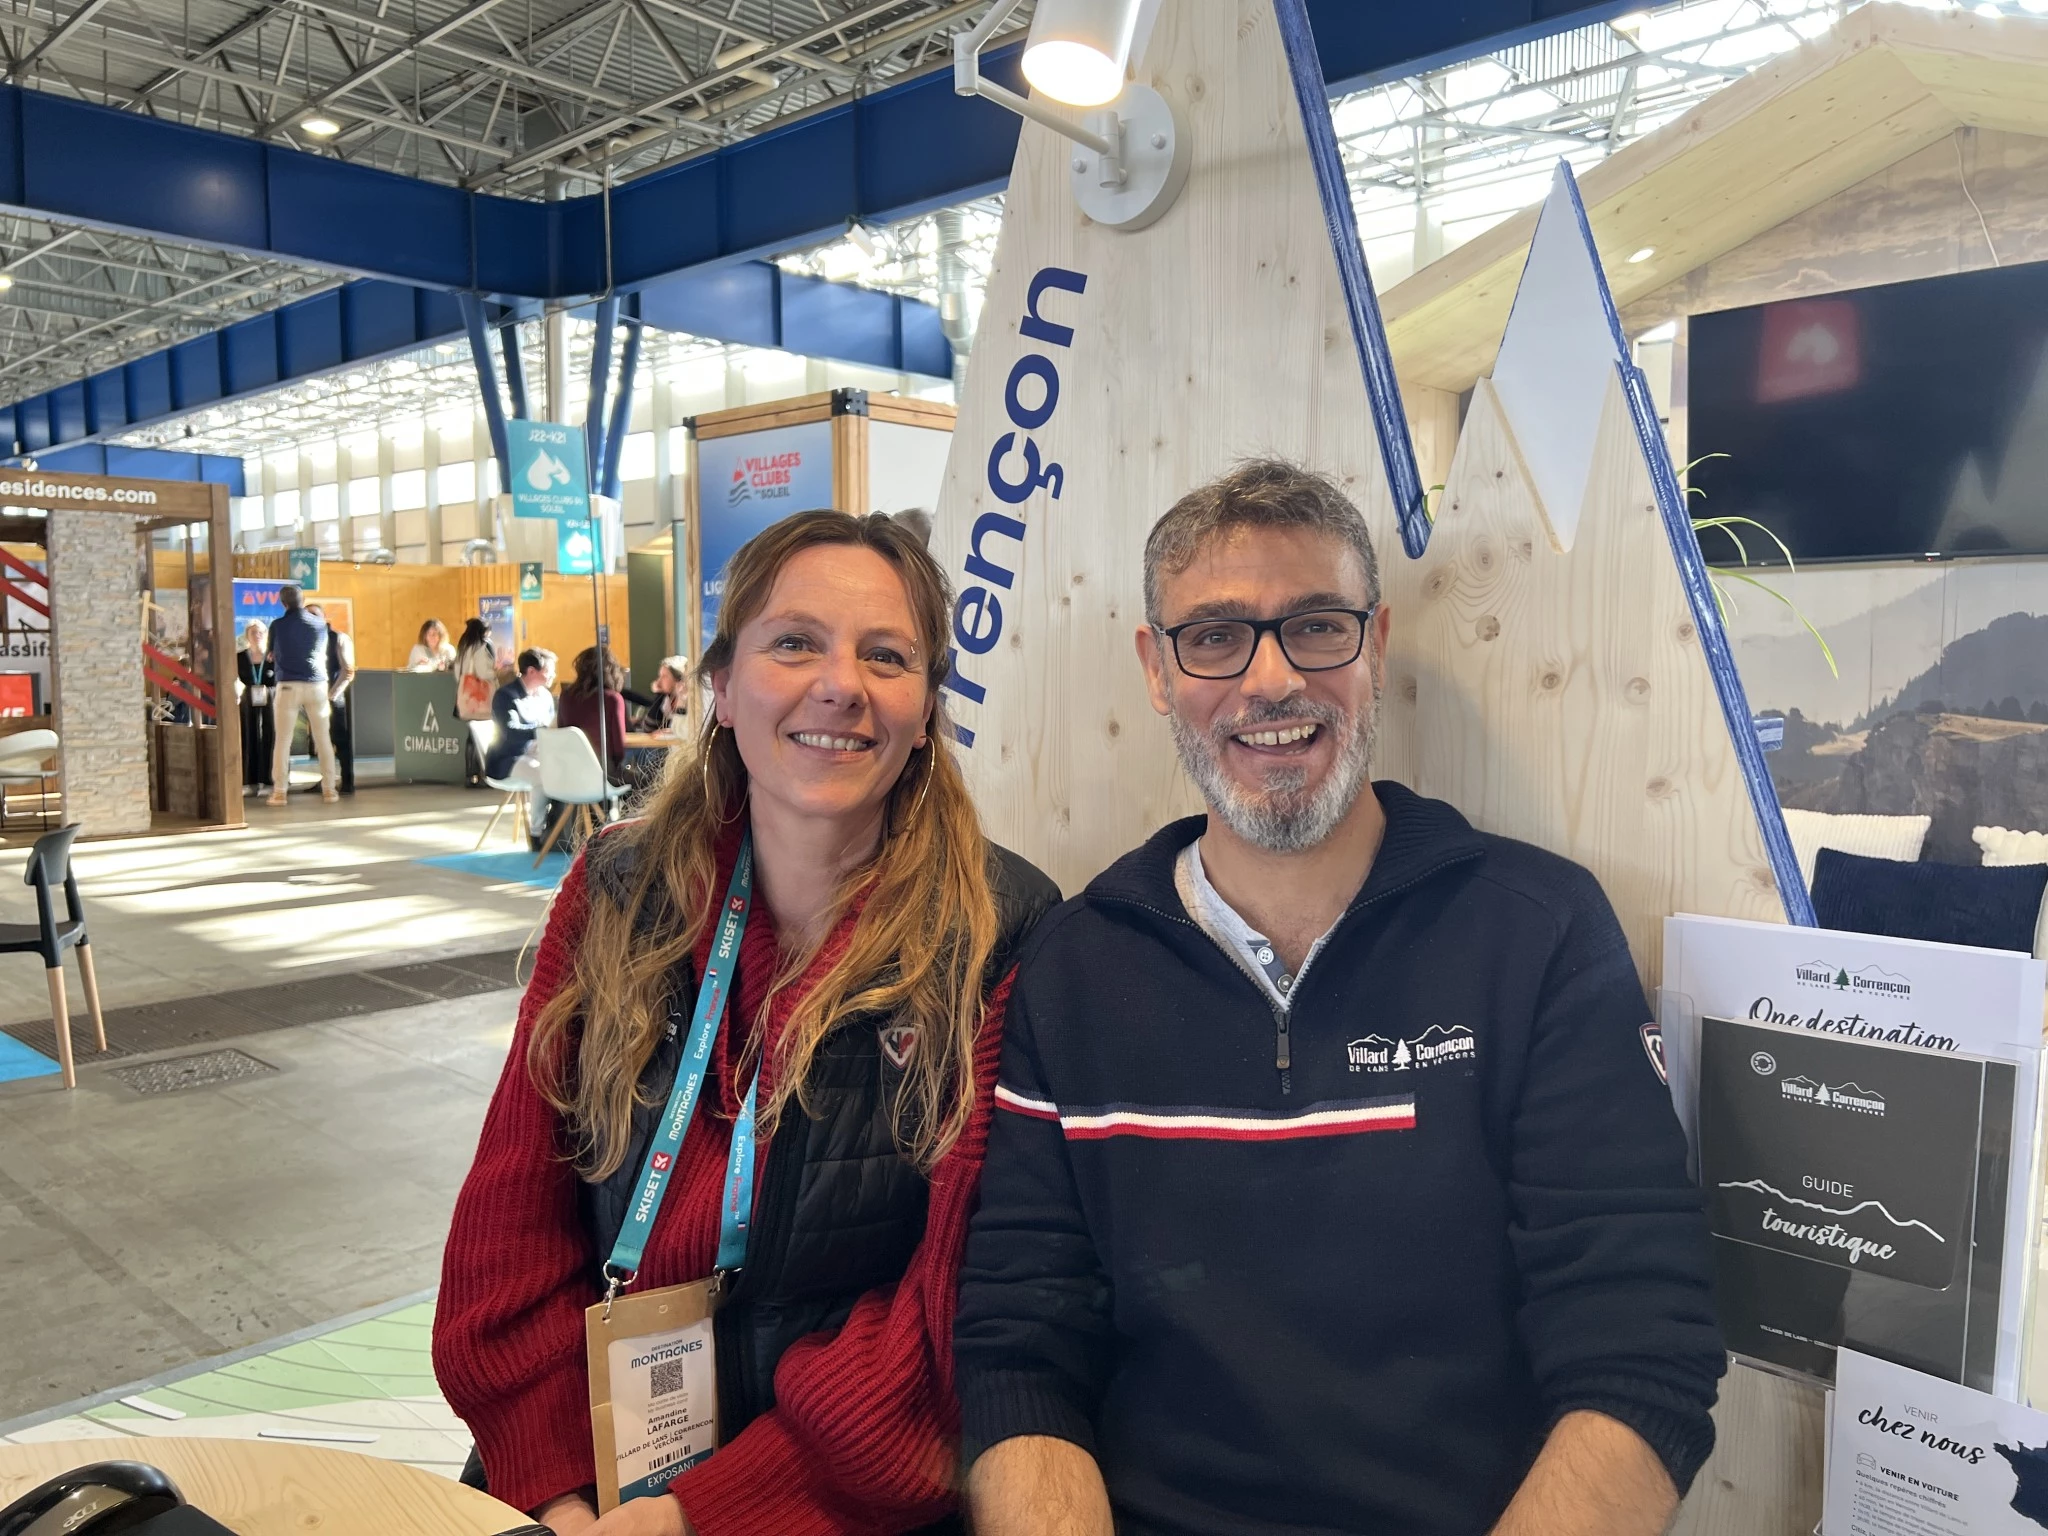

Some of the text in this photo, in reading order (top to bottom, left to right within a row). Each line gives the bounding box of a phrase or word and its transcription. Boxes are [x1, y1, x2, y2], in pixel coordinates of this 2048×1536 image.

[746, 452, 801, 472] VILLAGES
[0, 478, 157, 505] esidences.com
[752, 470, 791, 487] CLUBS
[761, 486, 790, 499] SOLEIL
[404, 735, 459, 755] CIMALPES
[718, 911, 740, 959] SKISET
[1796, 968, 1911, 994] Villard Corrençon
[1749, 996, 1960, 1051] One destination
[693, 1022, 712, 1060] Explore
[1347, 1046, 1388, 1065] Villard
[668, 1073, 698, 1141] MONTAGNES
[1781, 1082, 1885, 1111] Villard Corrençon
[734, 1135, 746, 1175] Explore
[635, 1170, 662, 1223] SKISET
[1802, 1175, 1854, 1198] GUIDE
[1762, 1207, 1896, 1264] touristique
[631, 1340, 703, 1369] MONTAGNES
[647, 1415, 689, 1435] LAFARGE
[648, 1407, 688, 1424] Amandine
[1903, 1404, 1939, 1423] VENIR
[642, 1441, 651, 1450] DE
[652, 1433, 668, 1445] LANS
[673, 1418, 714, 1436] CORRENCON
[654, 1434, 683, 1450] VERCORS
[1858, 1405, 1986, 1464] chez nous
[647, 1459, 695, 1488] EXPOSANT
[1856, 1469, 1888, 1487] Quelques
[1889, 1482, 1917, 1498] repères
[1880, 1466, 1959, 1501] VENIR EN VOITURE
